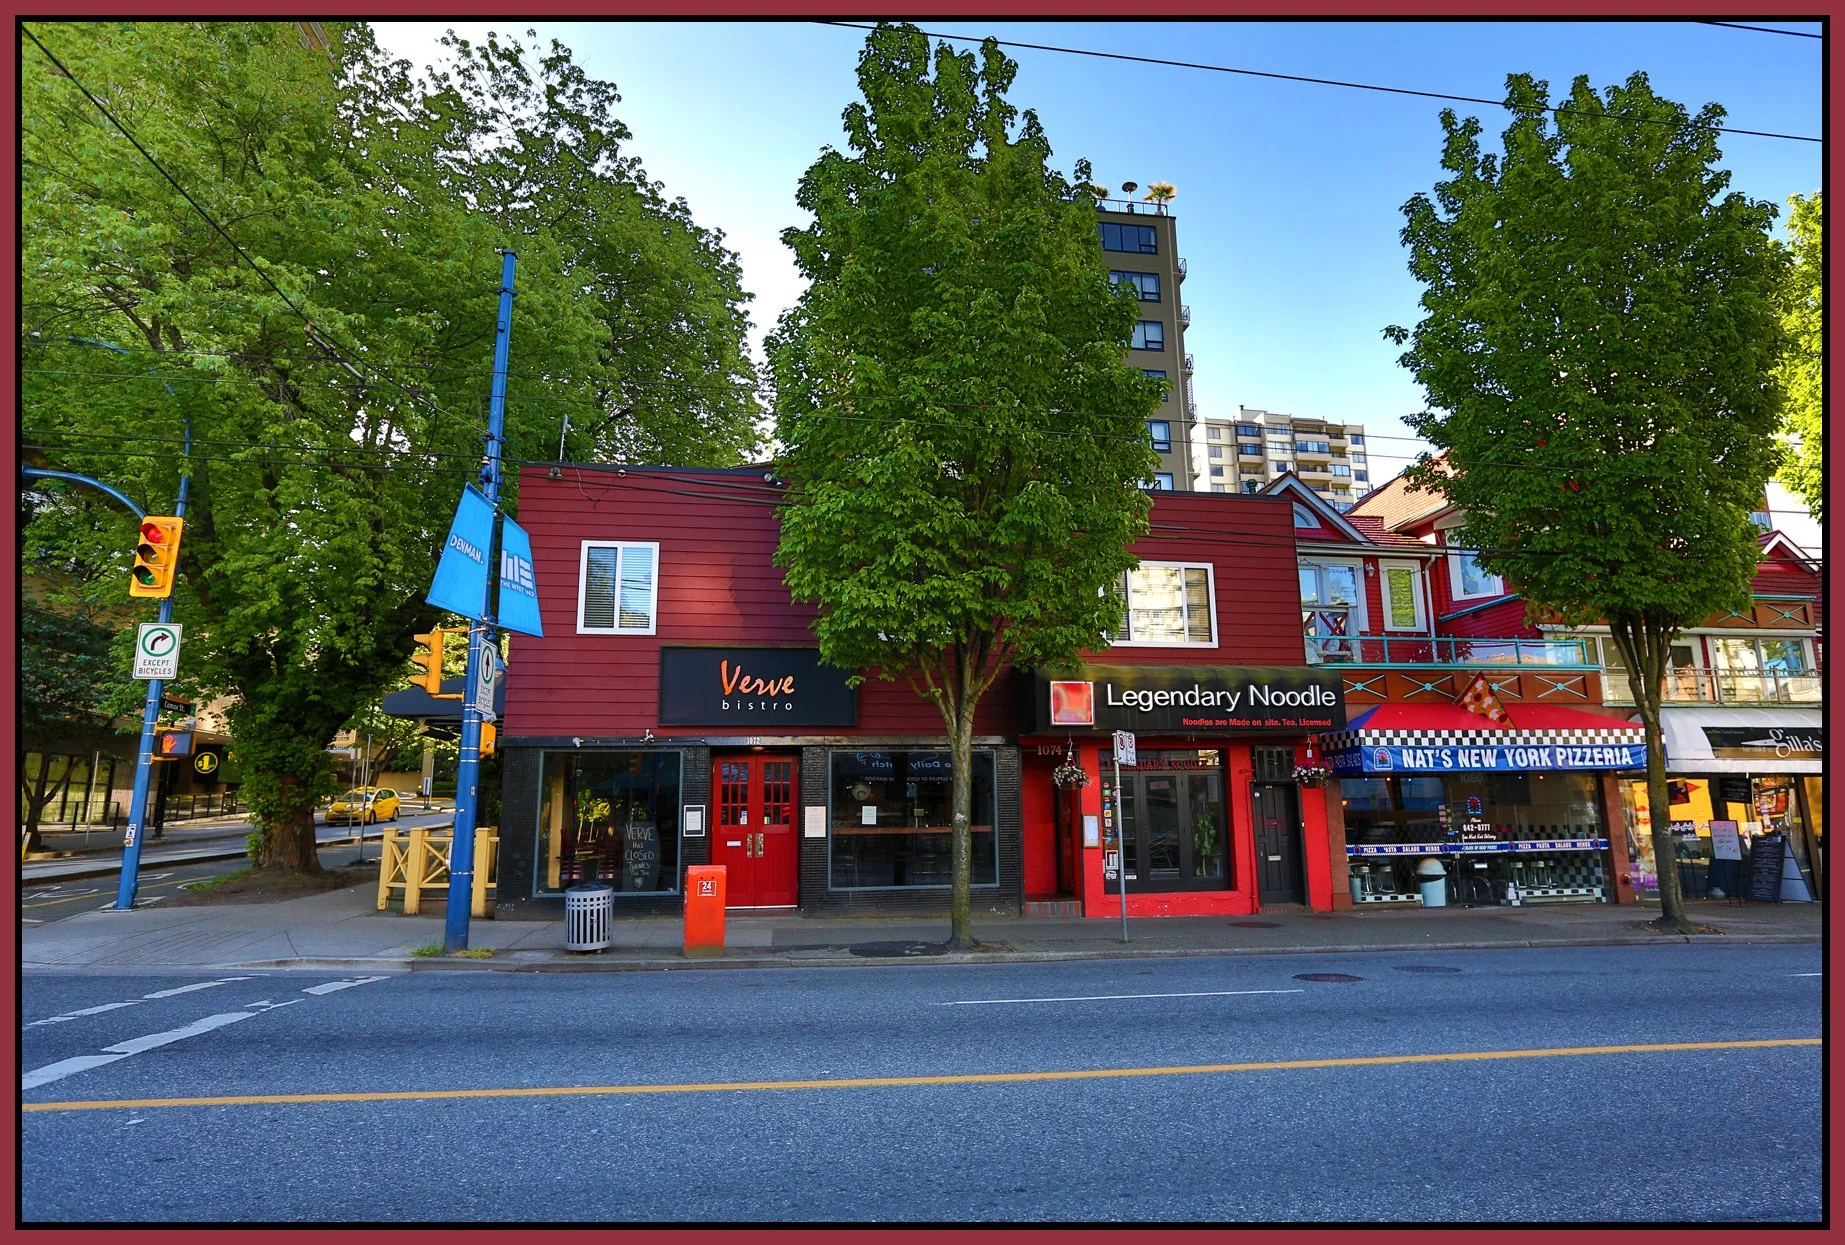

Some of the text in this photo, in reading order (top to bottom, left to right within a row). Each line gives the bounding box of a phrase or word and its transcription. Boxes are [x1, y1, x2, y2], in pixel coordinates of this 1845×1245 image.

[450, 535, 483, 564] DENMAN.
[143, 659, 170, 667] EXCEPT
[138, 667, 172, 675] BICYCLES
[720, 659, 795, 696] Verve
[1107, 683, 1336, 712] Legendary Noodle
[722, 700, 793, 710] bistro
[1182, 718, 1213, 726] Noodles
[1229, 718, 1250, 726] Made
[1299, 718, 1331, 726] Licensed
[747, 737, 760, 745] 1072
[1037, 745, 1062, 755] 1074
[1402, 748, 1453, 768] NAT'S
[1458, 748, 1497, 768] NEW
[1504, 748, 1552, 767] YORK
[1556, 747, 1634, 766] PIZZERIA
[625, 824, 655, 841] VERVE
[702, 881, 712, 890] 24
